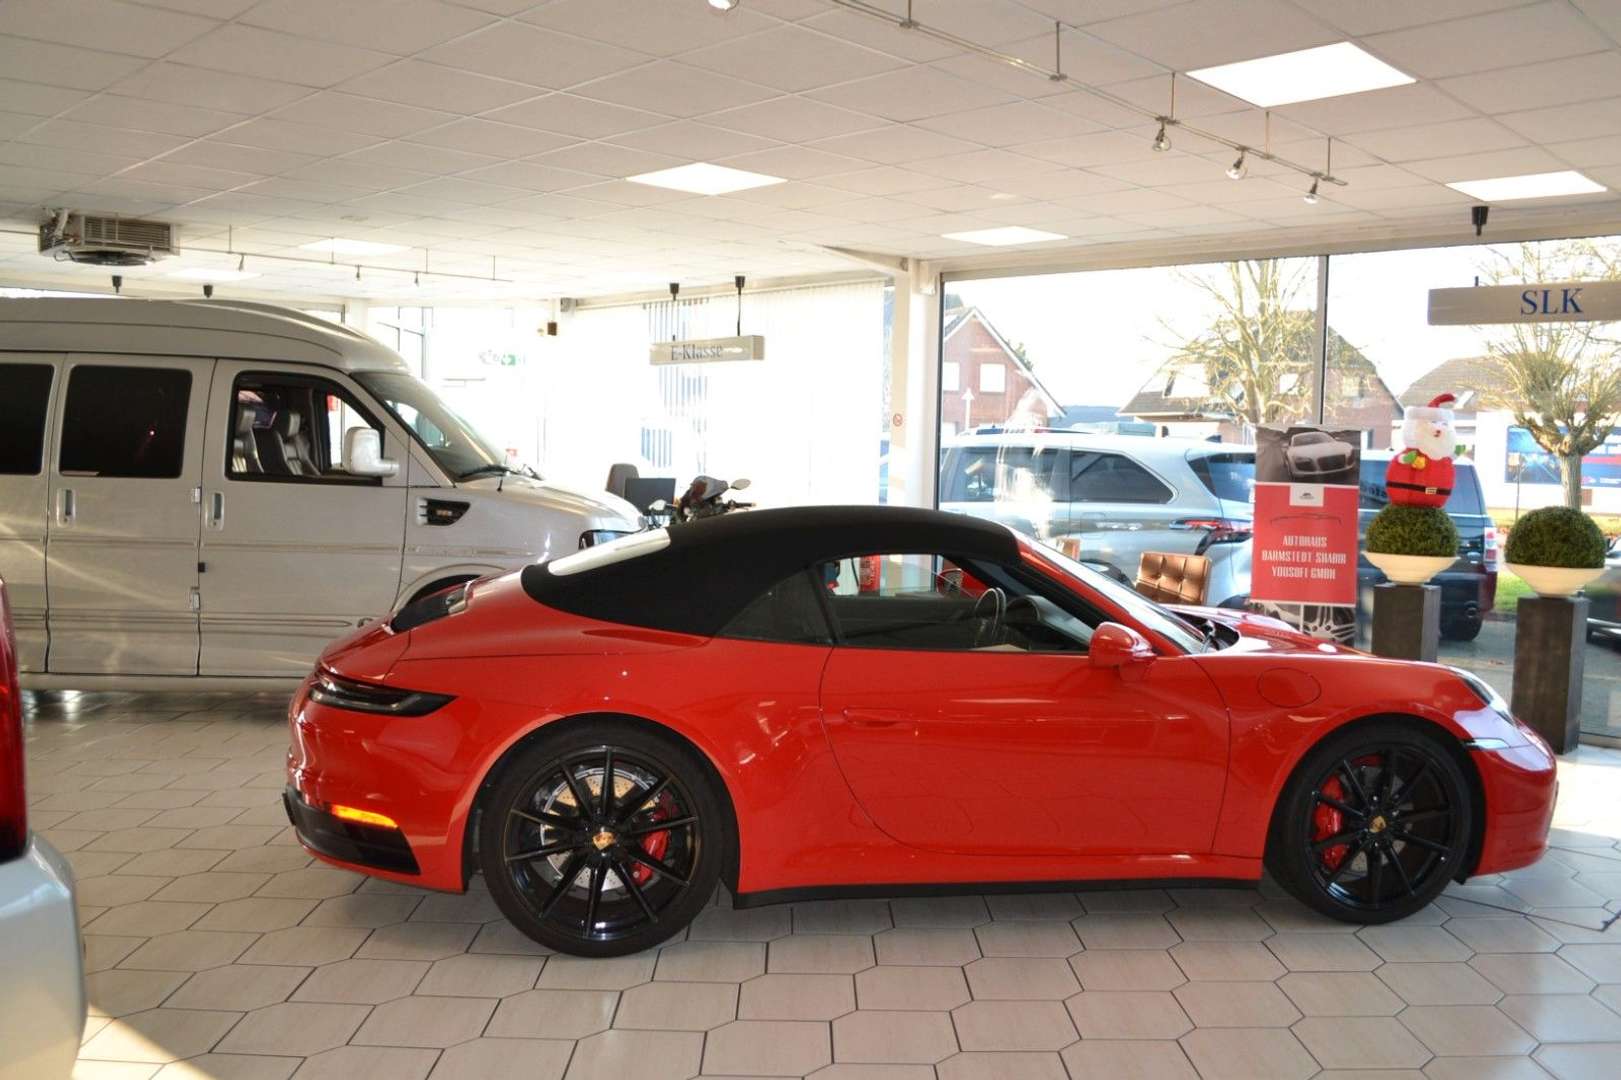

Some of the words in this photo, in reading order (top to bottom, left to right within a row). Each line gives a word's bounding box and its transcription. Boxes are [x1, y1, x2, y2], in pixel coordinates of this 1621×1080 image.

[1520, 288, 1583, 315] SLK
[671, 344, 722, 361] E-Klasse
[1282, 535, 1328, 547] AUTOHAUS
